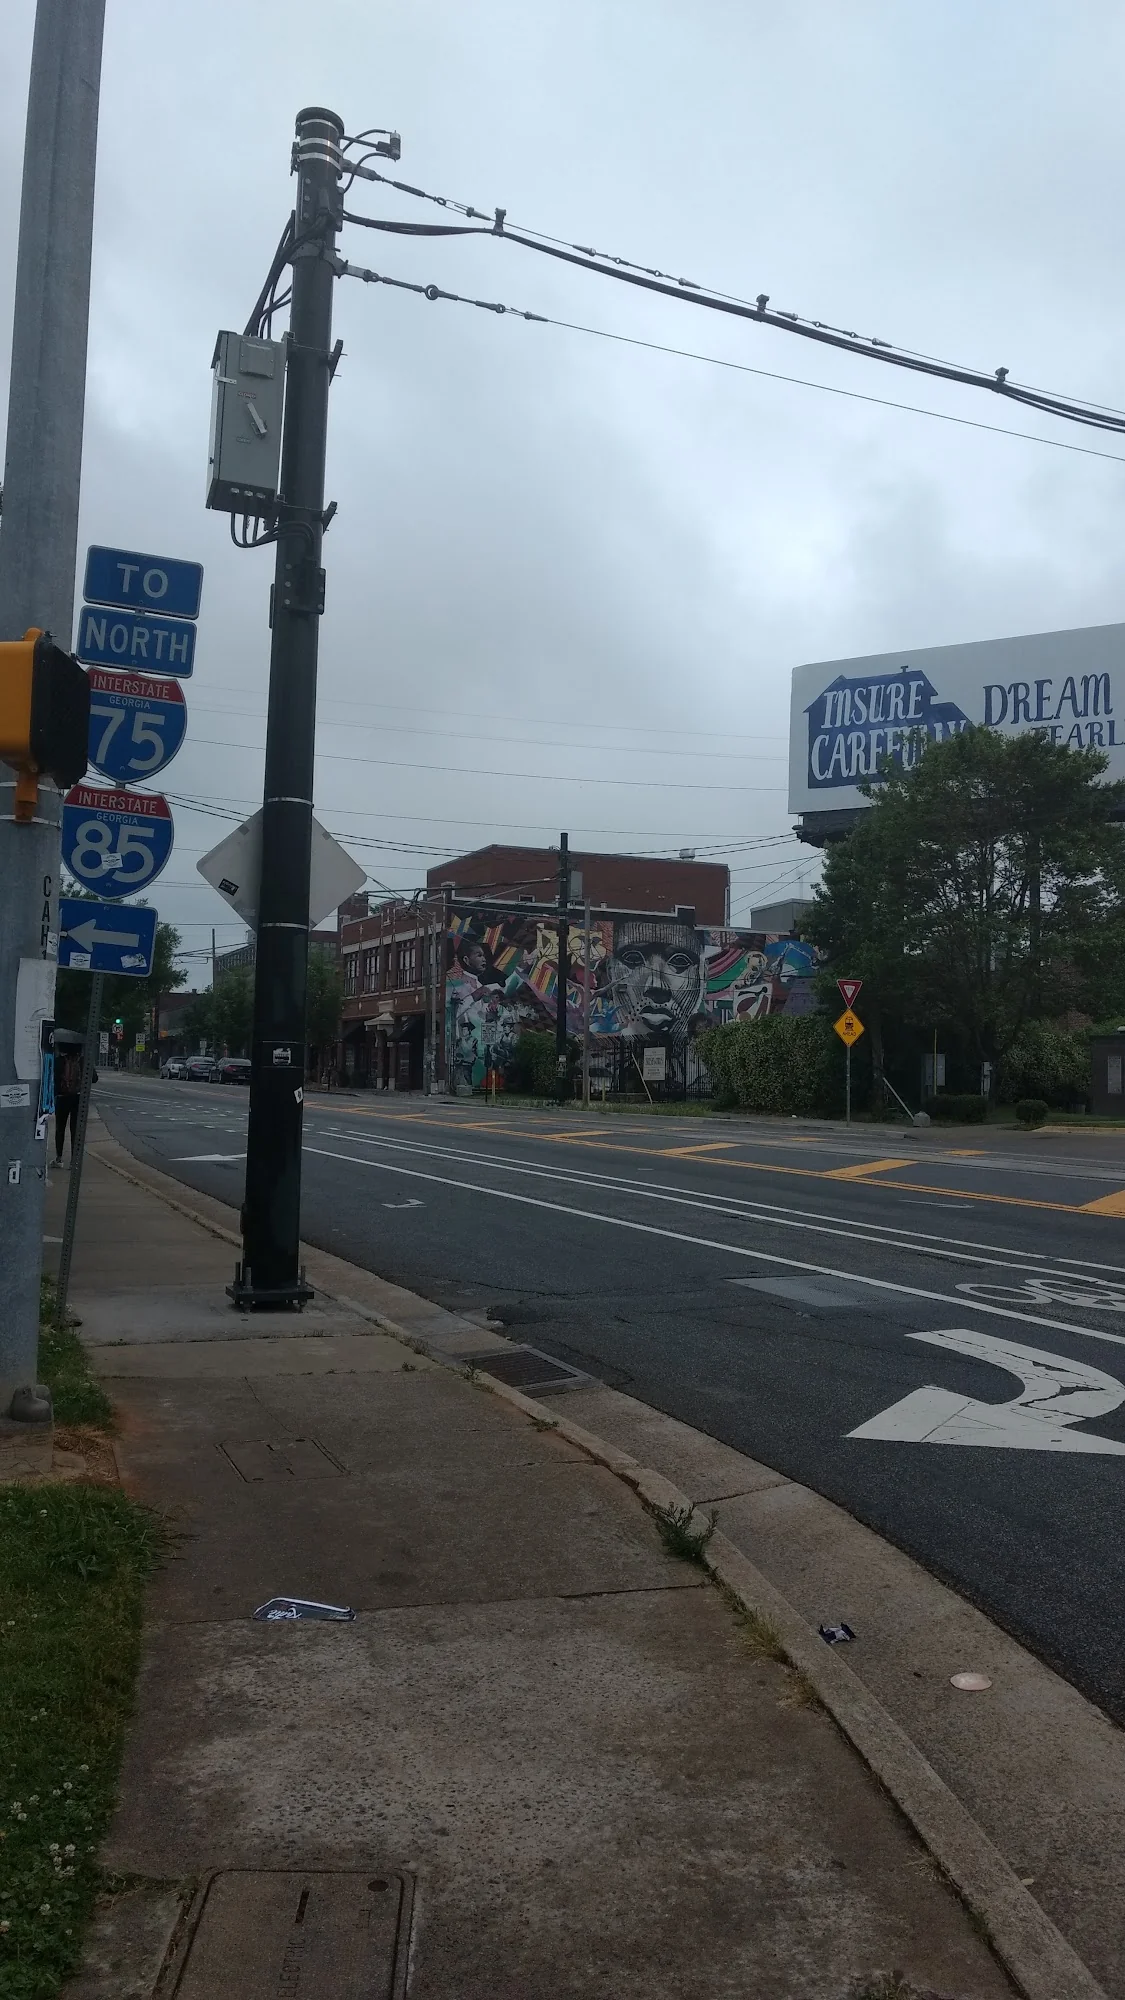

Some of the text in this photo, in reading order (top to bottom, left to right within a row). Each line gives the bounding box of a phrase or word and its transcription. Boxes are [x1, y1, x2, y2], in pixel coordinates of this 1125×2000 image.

[117, 562, 169, 599] TO
[84, 616, 189, 664] NORTH
[93, 674, 170, 699] INTERSTATE
[109, 695, 151, 710] GEORGIA
[820, 680, 925, 730] INSURE
[982, 671, 1115, 727] DREAM
[90, 704, 166, 771] 75
[78, 790, 158, 815] INTERSTATE
[96, 812, 139, 826] GEORGIA
[70, 819, 155, 884] 85
[276, 1937, 306, 1999] ELECTRIC
